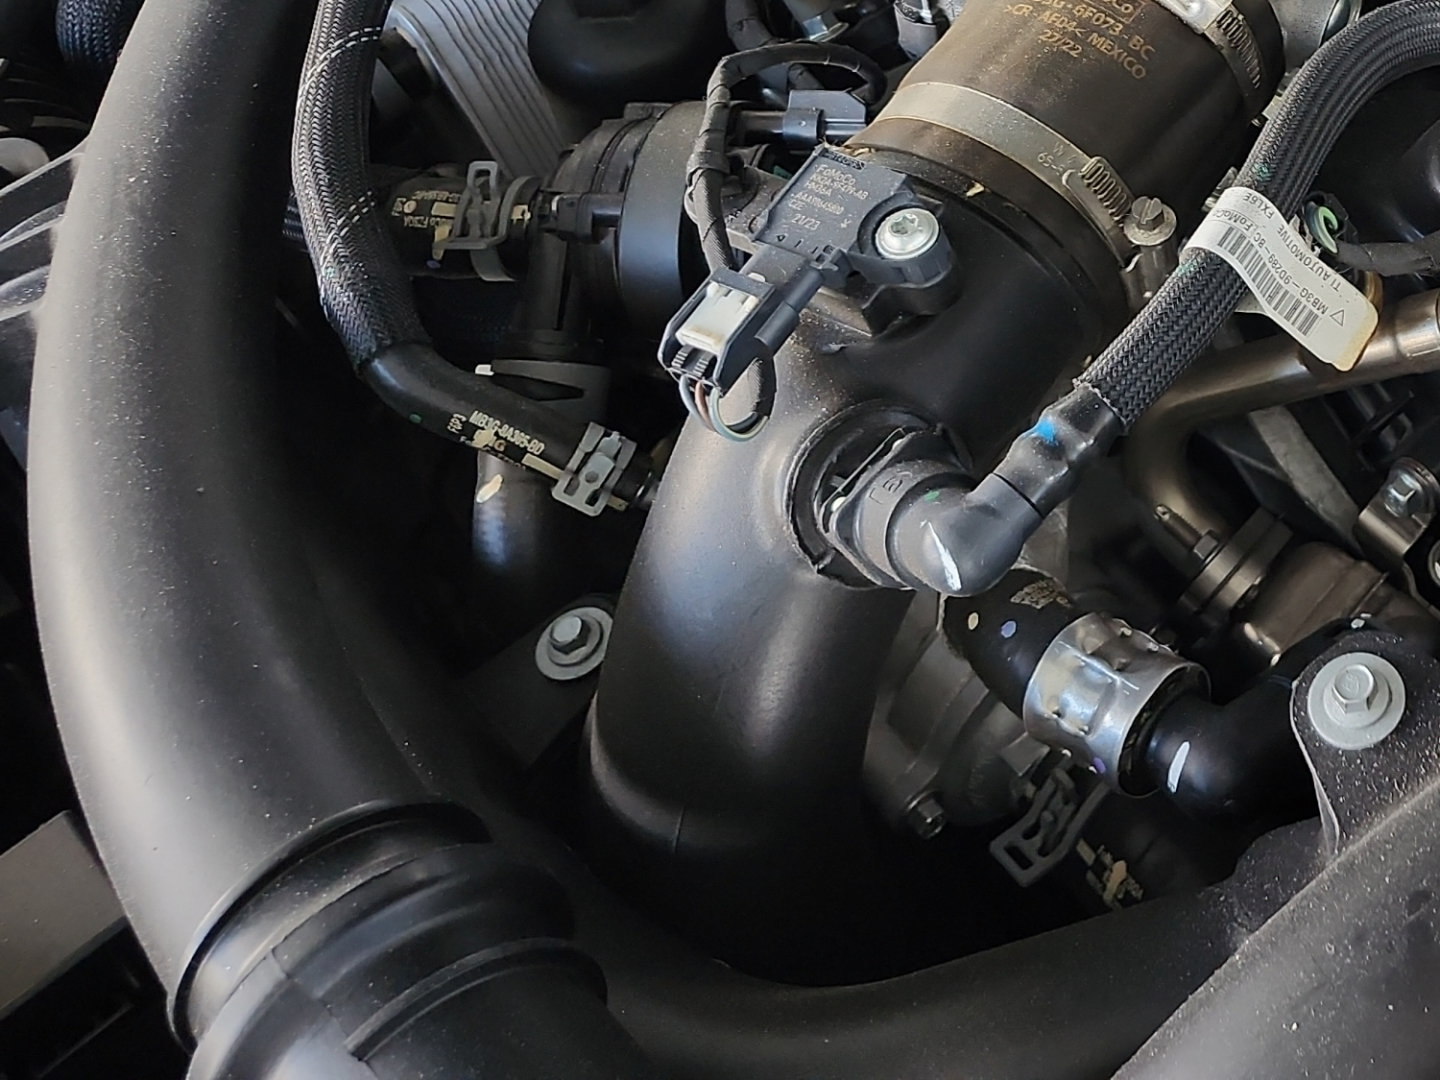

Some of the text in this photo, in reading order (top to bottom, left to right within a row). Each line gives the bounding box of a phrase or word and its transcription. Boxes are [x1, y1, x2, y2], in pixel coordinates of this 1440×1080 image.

[1039, 29, 1083, 58] 27/22
[1087, 32, 1147, 79] MEXICO
[1242, 192, 1275, 220] FXL6E
[1277, 223, 1333, 282] AUTOMOTIVE
